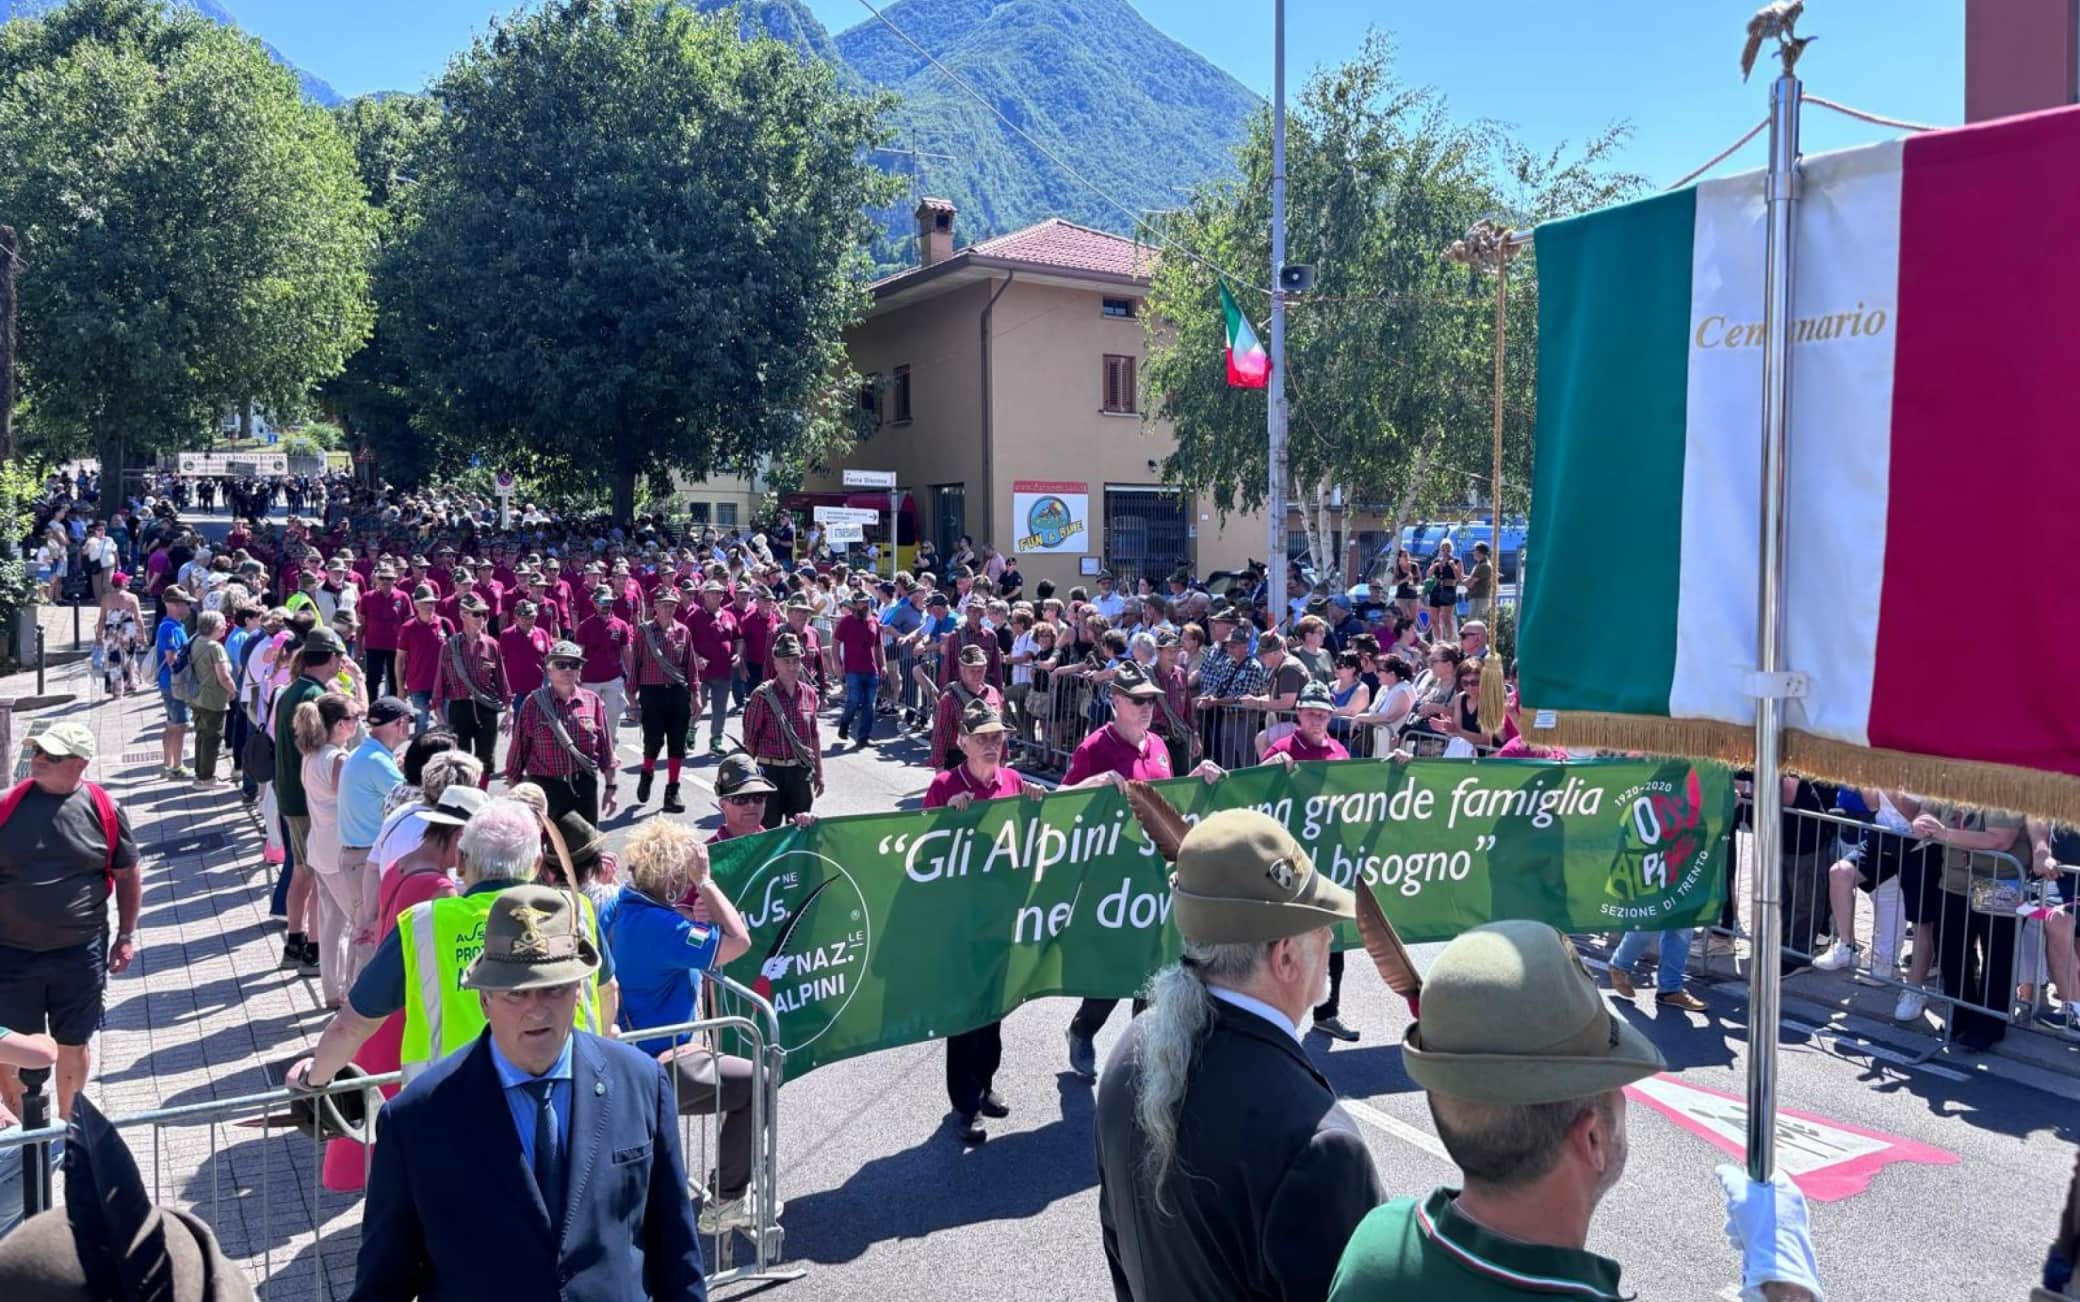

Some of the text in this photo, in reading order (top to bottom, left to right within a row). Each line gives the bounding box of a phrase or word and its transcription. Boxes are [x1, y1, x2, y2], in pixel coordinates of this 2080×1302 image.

[1695, 301, 1887, 349] Cennario
[1018, 533, 1044, 551] FUN
[1614, 781, 1673, 807] 1920-2020
[983, 809, 1124, 883] Alpini
[1302, 777, 1434, 840] grande
[1448, 777, 1604, 828] famiglia
[1600, 850, 1709, 919] SEZIONE DI TRENTO
[774, 973, 845, 1014] ALPINI
